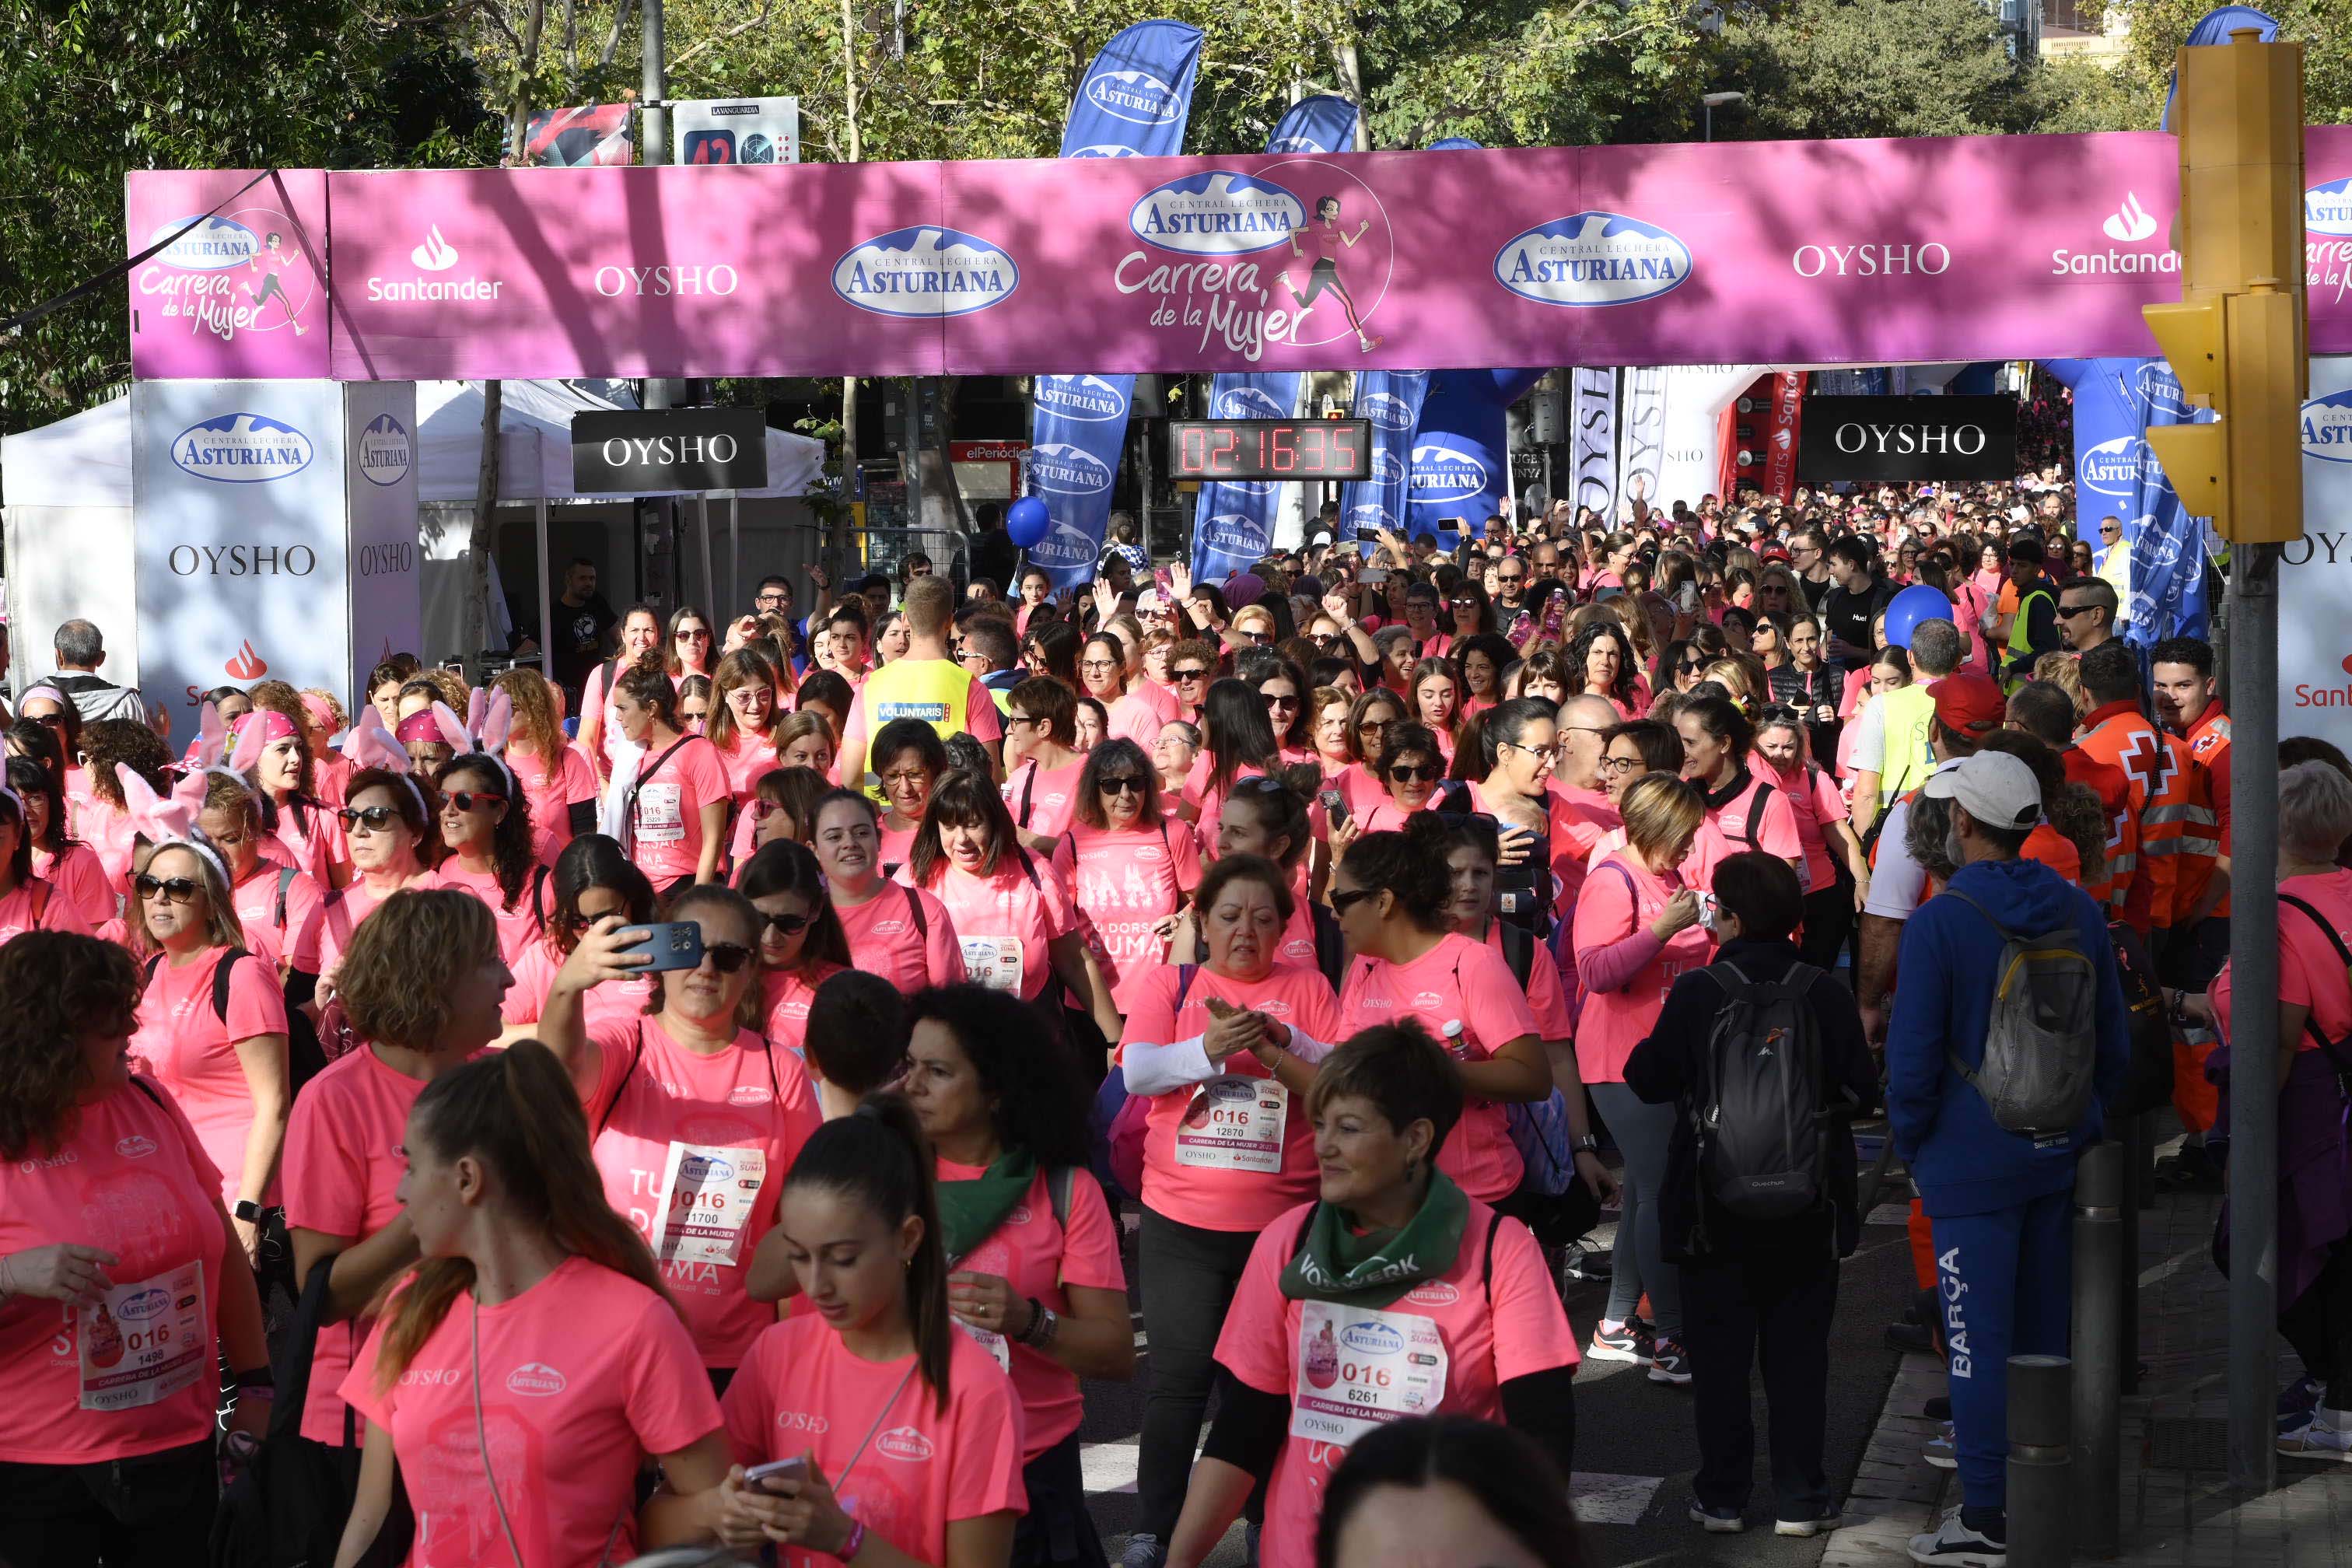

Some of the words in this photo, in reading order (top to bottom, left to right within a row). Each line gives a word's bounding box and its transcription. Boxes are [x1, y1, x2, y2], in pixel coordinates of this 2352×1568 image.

[1170, 199, 1225, 209] CENTRAL
[1230, 199, 1287, 208] LECHERA
[1142, 202, 1293, 235] ASTURIANA
[1539, 246, 1601, 255] CENTRAL
[1607, 243, 1671, 254] LECHERA
[1793, 242, 1951, 277] OYSHO
[875, 257, 933, 267] CENTRAL
[940, 257, 997, 266] LECHERA
[1114, 250, 1260, 295] Carrera
[1509, 248, 1678, 284] ASTURIANA
[2052, 248, 2182, 275] Santand
[138, 265, 231, 296] Carrera
[595, 264, 738, 296] OYSHO
[845, 260, 1004, 294] ASTURIANA
[367, 277, 503, 302] Santander
[161, 297, 179, 317] de
[183, 296, 195, 317] la
[193, 292, 266, 341] Mujer
[1150, 298, 1177, 327] de
[1183, 295, 1202, 327] la
[1199, 288, 1315, 362] Mujer
[1048, 382, 1080, 393] CENTRAL
[1083, 388, 1116, 400] LECHERA
[1181, 429, 1355, 471] 02:16:35
[1836, 422, 1986, 454] OYSHO
[181, 439, 303, 466] ASTURIANA
[362, 440, 408, 468] ASTURIANA
[603, 434, 737, 467] OYSHO
[967, 446, 1019, 459] elPeriódi
[1031, 463, 1104, 487] STURIANA
[1205, 527, 1265, 554] ASTURIANA
[169, 544, 316, 576] OYSHO
[360, 541, 411, 576] OYSHO
[880, 708, 941, 717] VOLUNTARIS
[644, 807, 661, 815] 016
[1363, 998, 1392, 1009] OYSHO
[1213, 1087, 1252, 1099] ASTURIANA
[1213, 1109, 1249, 1125] 016
[1216, 1127, 1244, 1137] 12870
[21, 1150, 78, 1174] OYSHO
[1186, 1150, 1216, 1160] OYSHO
[1241, 1154, 1273, 1164] Santander
[682, 1162, 730, 1177] ASTURIANA
[681, 1192, 725, 1209] 016
[1937, 1247, 1972, 1379] BARÇA
[128, 1324, 170, 1351] 016
[1344, 1332, 1400, 1349] ASTURIANA
[1342, 1363, 1392, 1387] 016
[95, 1388, 138, 1404] OYSHO
[1348, 1389, 1378, 1404] 6261
[1311, 1401, 1345, 1413] CARRERA
[1346, 1407, 1358, 1416] DE
[1359, 1409, 1370, 1418] LA
[1304, 1418, 1344, 1434] OYSHO
